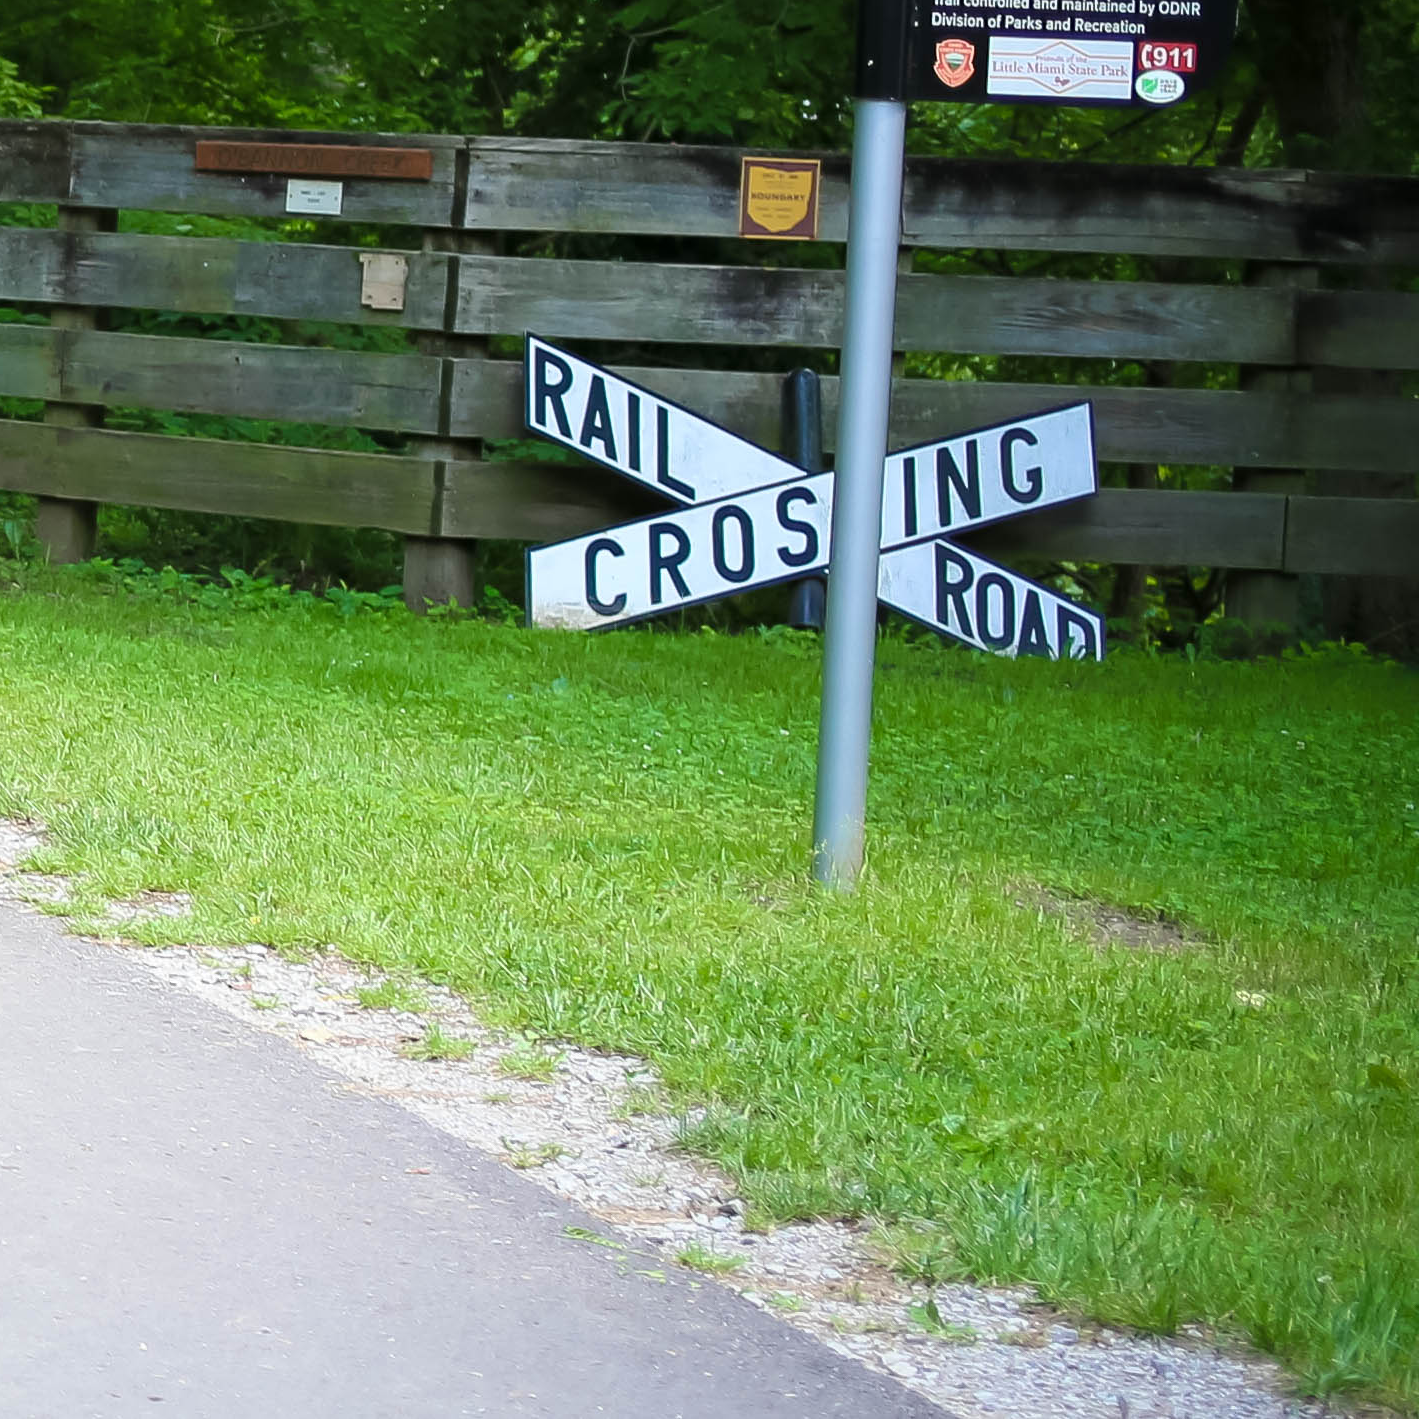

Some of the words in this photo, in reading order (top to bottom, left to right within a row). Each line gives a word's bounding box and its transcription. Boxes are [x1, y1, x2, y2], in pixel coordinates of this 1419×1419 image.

[1139, 0, 1155, 17] by
[1158, 1, 1201, 16] ODNR
[931, 12, 984, 28] Division
[988, 14, 1002, 28] of
[1005, 15, 1042, 30] Parks
[1046, 17, 1071, 31] and
[1074, 18, 1146, 34] Recreation
[1153, 46, 1193, 68] 911
[992, 60, 1024, 73] Little
[1027, 61, 1065, 75] Miami
[1068, 62, 1097, 76] State
[1101, 63, 1129, 77] Park
[534, 346, 696, 502] RAIL
[584, 427, 1043, 616] CROSING
